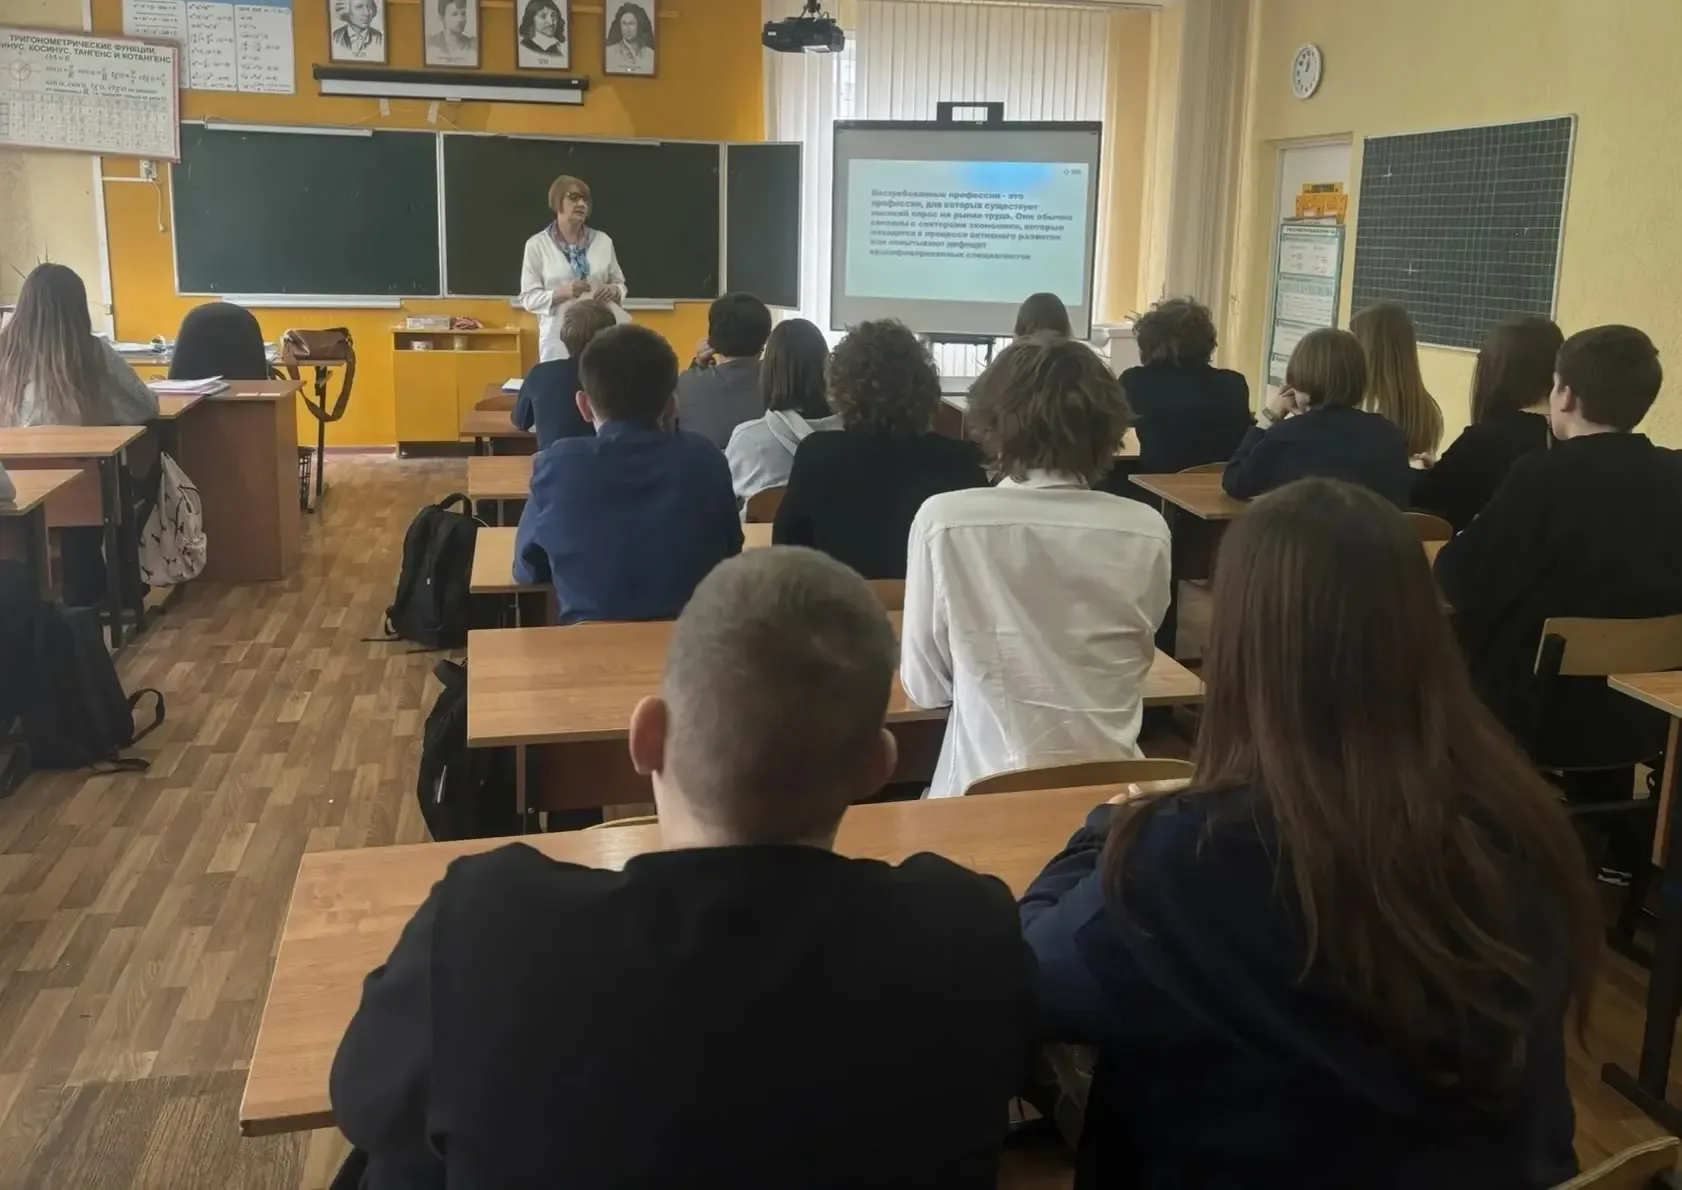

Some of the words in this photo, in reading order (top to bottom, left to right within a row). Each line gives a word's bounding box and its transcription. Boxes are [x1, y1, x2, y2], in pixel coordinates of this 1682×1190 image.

[10, 34, 112, 50] ТРИГОНОМЕТРИЧЕСКИЕ
[0, 42, 27, 52] ИНУС,
[29, 44, 72, 55] КОСИНУС,
[74, 48, 112, 58] ТАНГЕНС
[114, 52, 120, 60] И
[122, 52, 172, 64] КОТАНГЕНС
[948, 191, 1001, 200] профессии
[926, 201, 942, 209] для
[944, 202, 982, 210] которых
[984, 203, 1038, 211] существует
[911, 211, 938, 219] спрос
[953, 212, 984, 220] рынке
[1015, 212, 1035, 220] Они
[1036, 212, 1073, 221] обычно
[1024, 223, 1065, 232] которые
[969, 232, 1017, 240] активного
